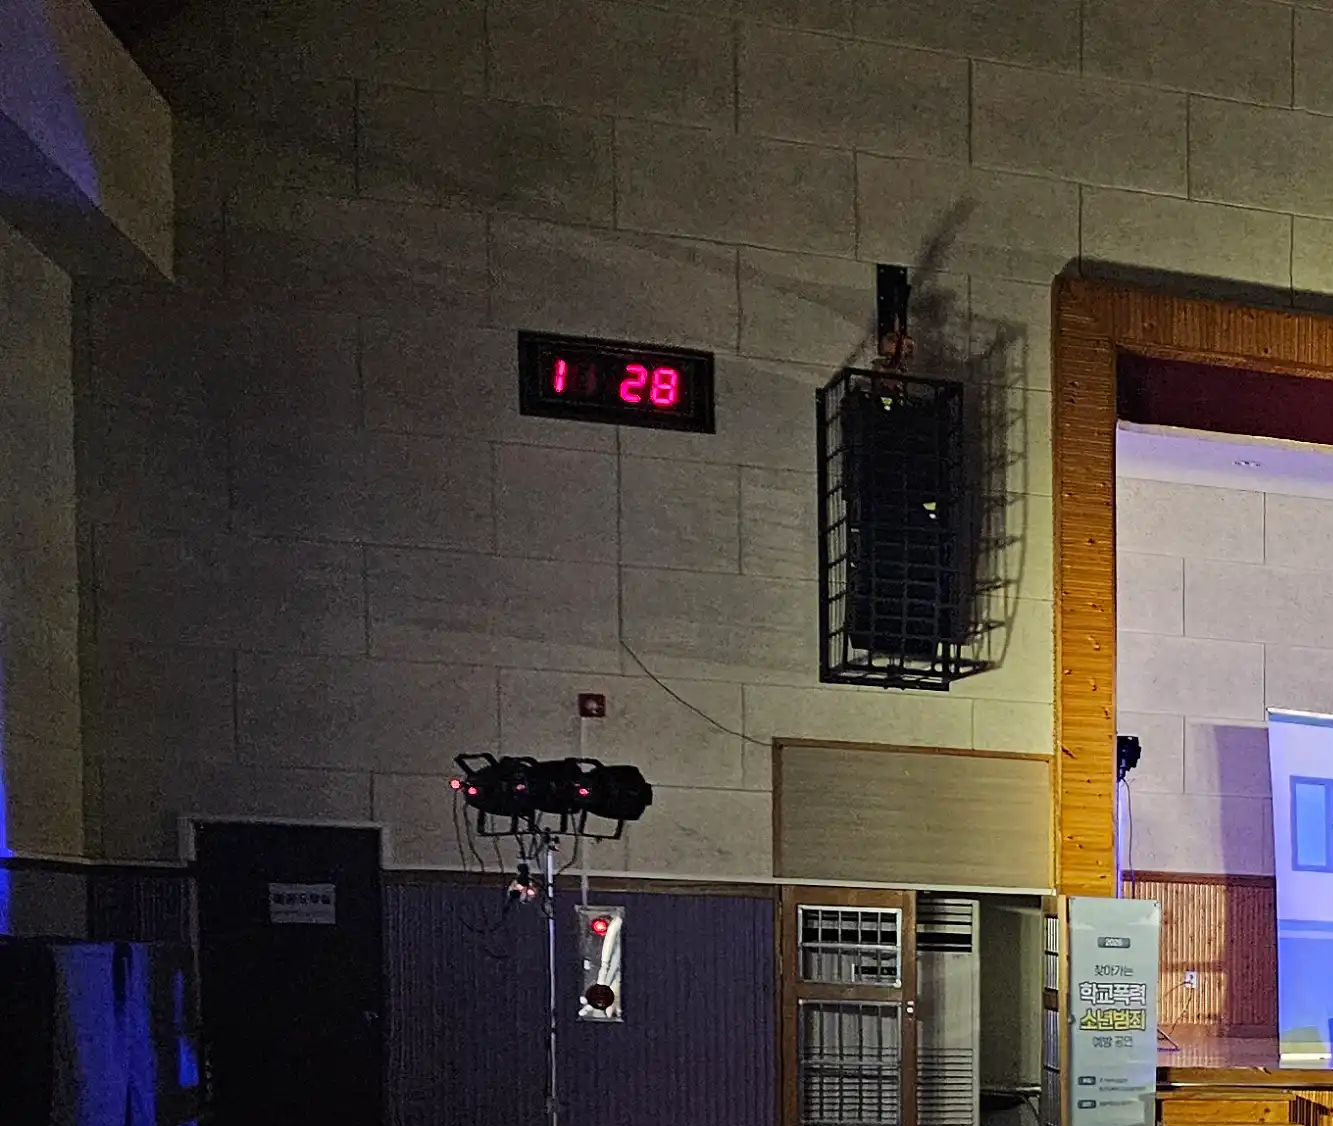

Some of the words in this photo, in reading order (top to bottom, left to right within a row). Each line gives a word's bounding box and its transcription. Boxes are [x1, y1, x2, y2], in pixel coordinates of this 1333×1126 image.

[619, 364, 679, 405] 28
[1094, 964, 1134, 977] 찾아가는
[1079, 981, 1147, 1006] 학교폭력
[1079, 1008, 1147, 1031] 소년범죄
